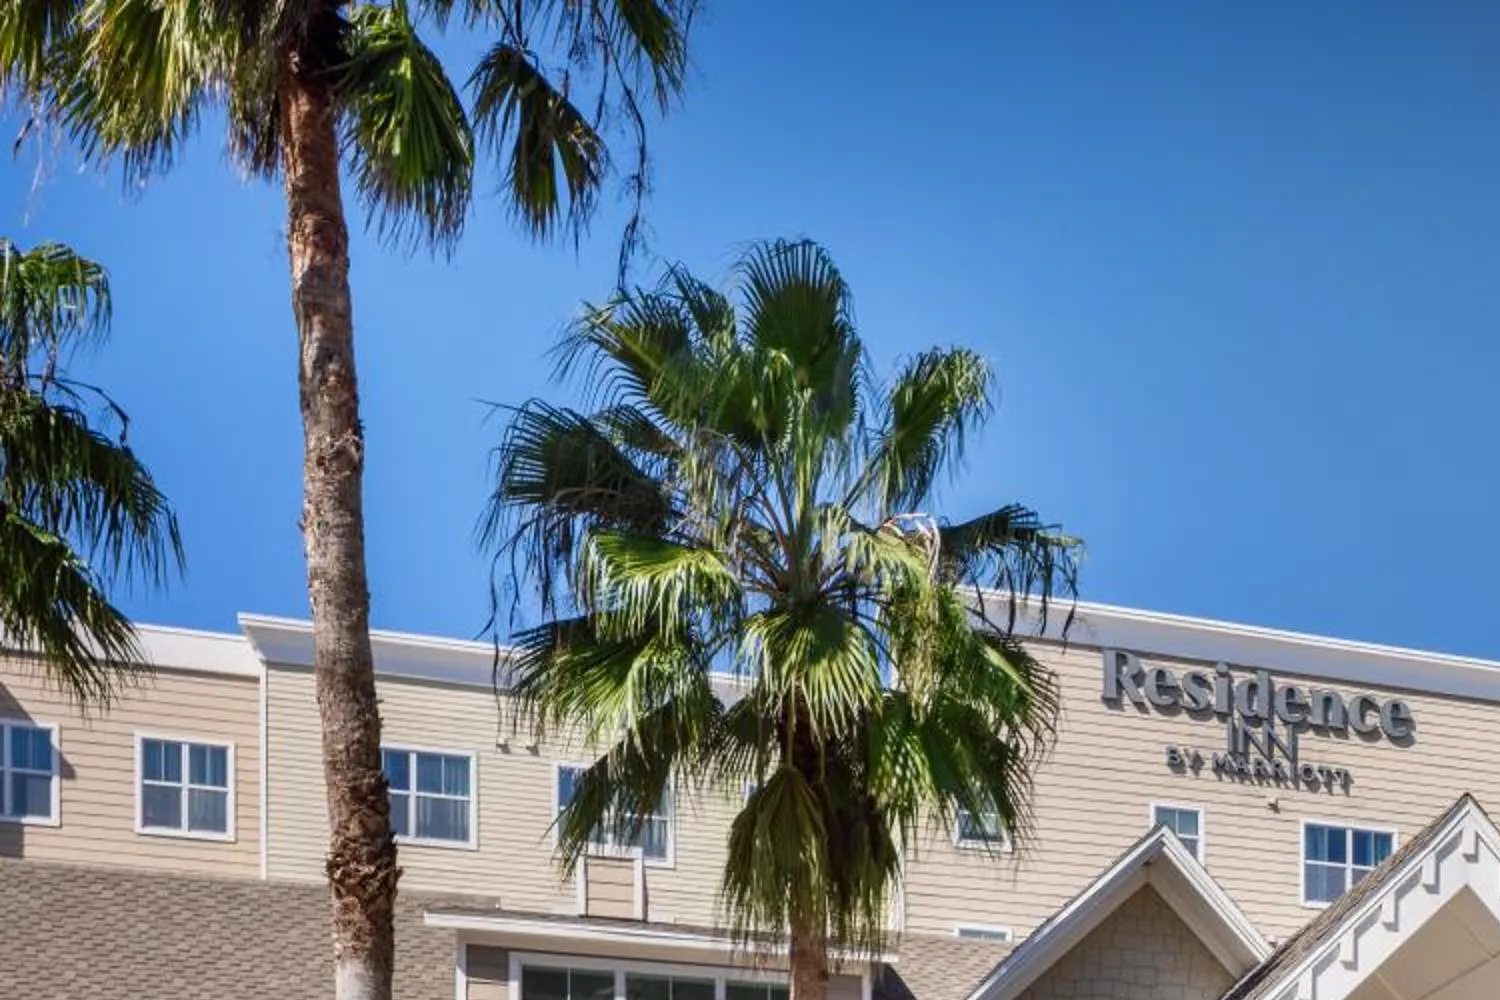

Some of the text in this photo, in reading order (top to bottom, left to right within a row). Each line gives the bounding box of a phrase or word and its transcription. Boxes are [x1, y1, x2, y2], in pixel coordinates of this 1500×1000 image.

[1101, 649, 1414, 737] Residence
[1227, 714, 1296, 763] INN
[1166, 744, 1350, 785] BY MARRIOTT
